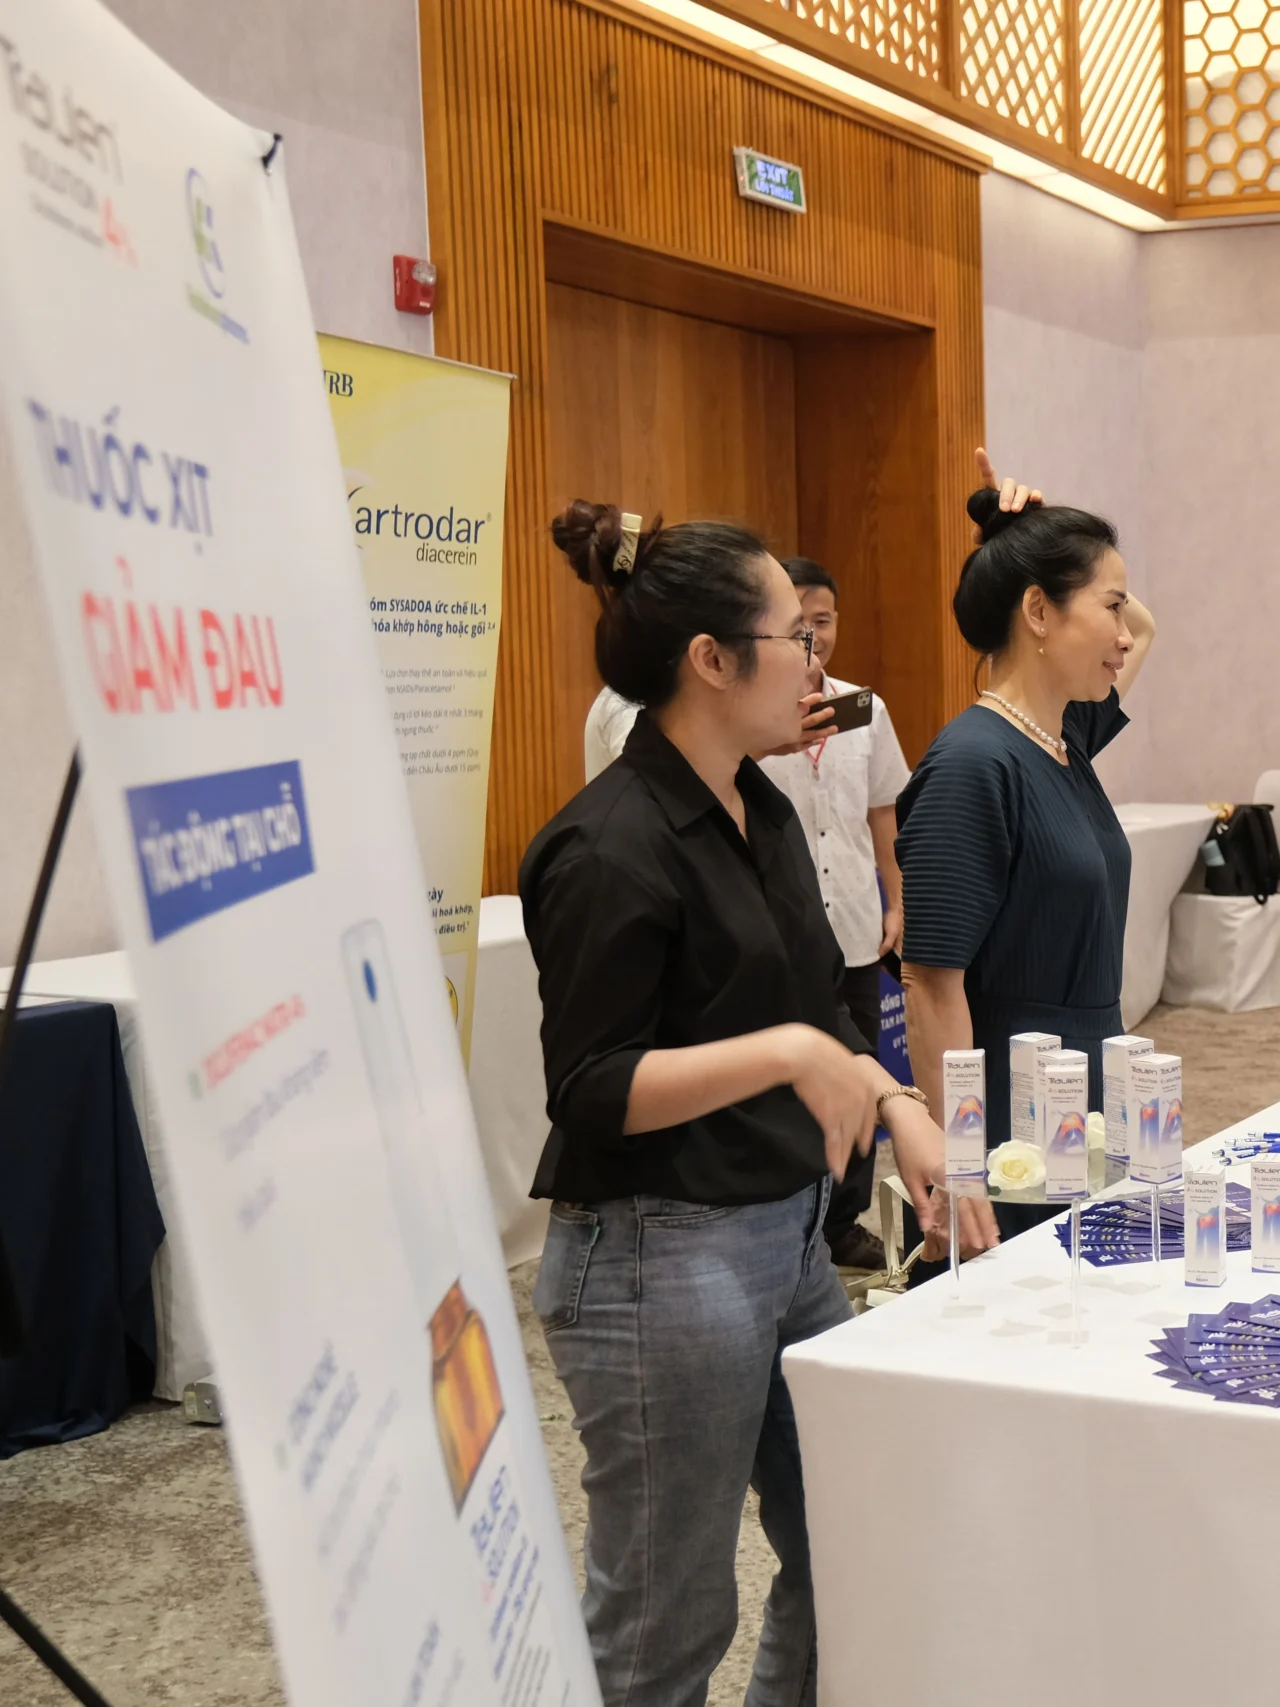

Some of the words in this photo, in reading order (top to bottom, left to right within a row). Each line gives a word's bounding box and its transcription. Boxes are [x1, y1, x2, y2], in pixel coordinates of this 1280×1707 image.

[756, 159, 788, 185] EXIT
[161, 450, 213, 556] XỊT
[416, 542, 477, 566] diacerein
[389, 599, 432, 614] SYSADOA
[451, 600, 468, 615] chế
[393, 618, 415, 636] khớp
[417, 619, 443, 637] hông
[446, 620, 468, 638] hoặc
